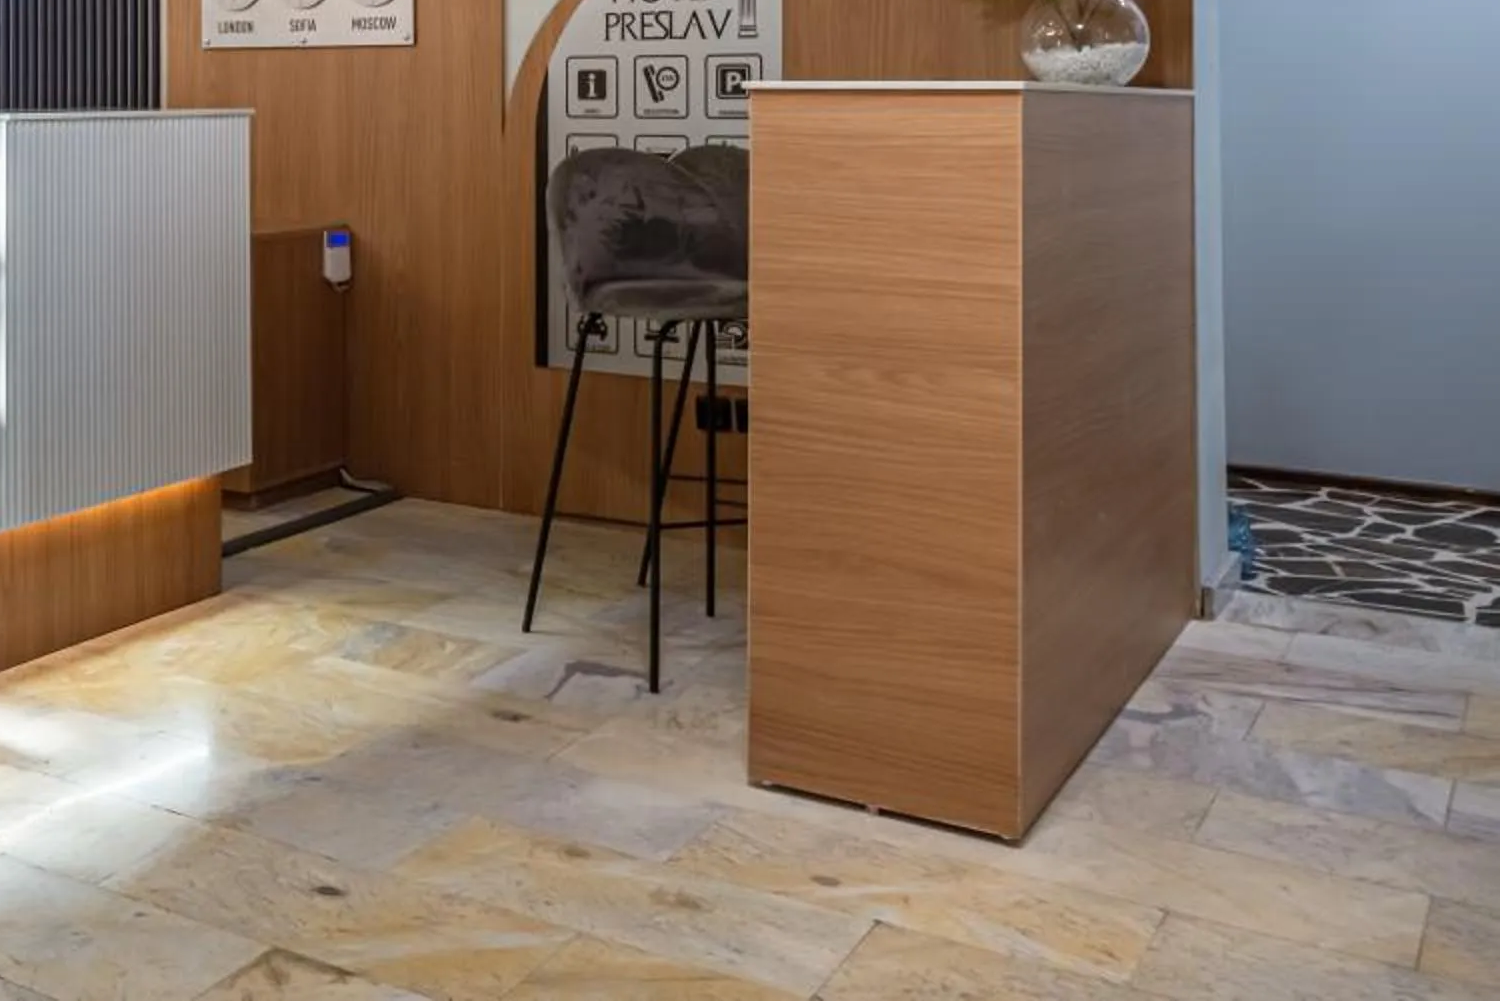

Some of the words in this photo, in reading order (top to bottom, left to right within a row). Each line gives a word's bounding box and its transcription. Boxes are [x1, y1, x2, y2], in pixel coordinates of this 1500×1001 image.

[217, 20, 255, 35] LONDON
[288, 18, 318, 33] SOFIA
[351, 16, 398, 32] MOSCOW
[604, 8, 733, 42] PRESLAV
